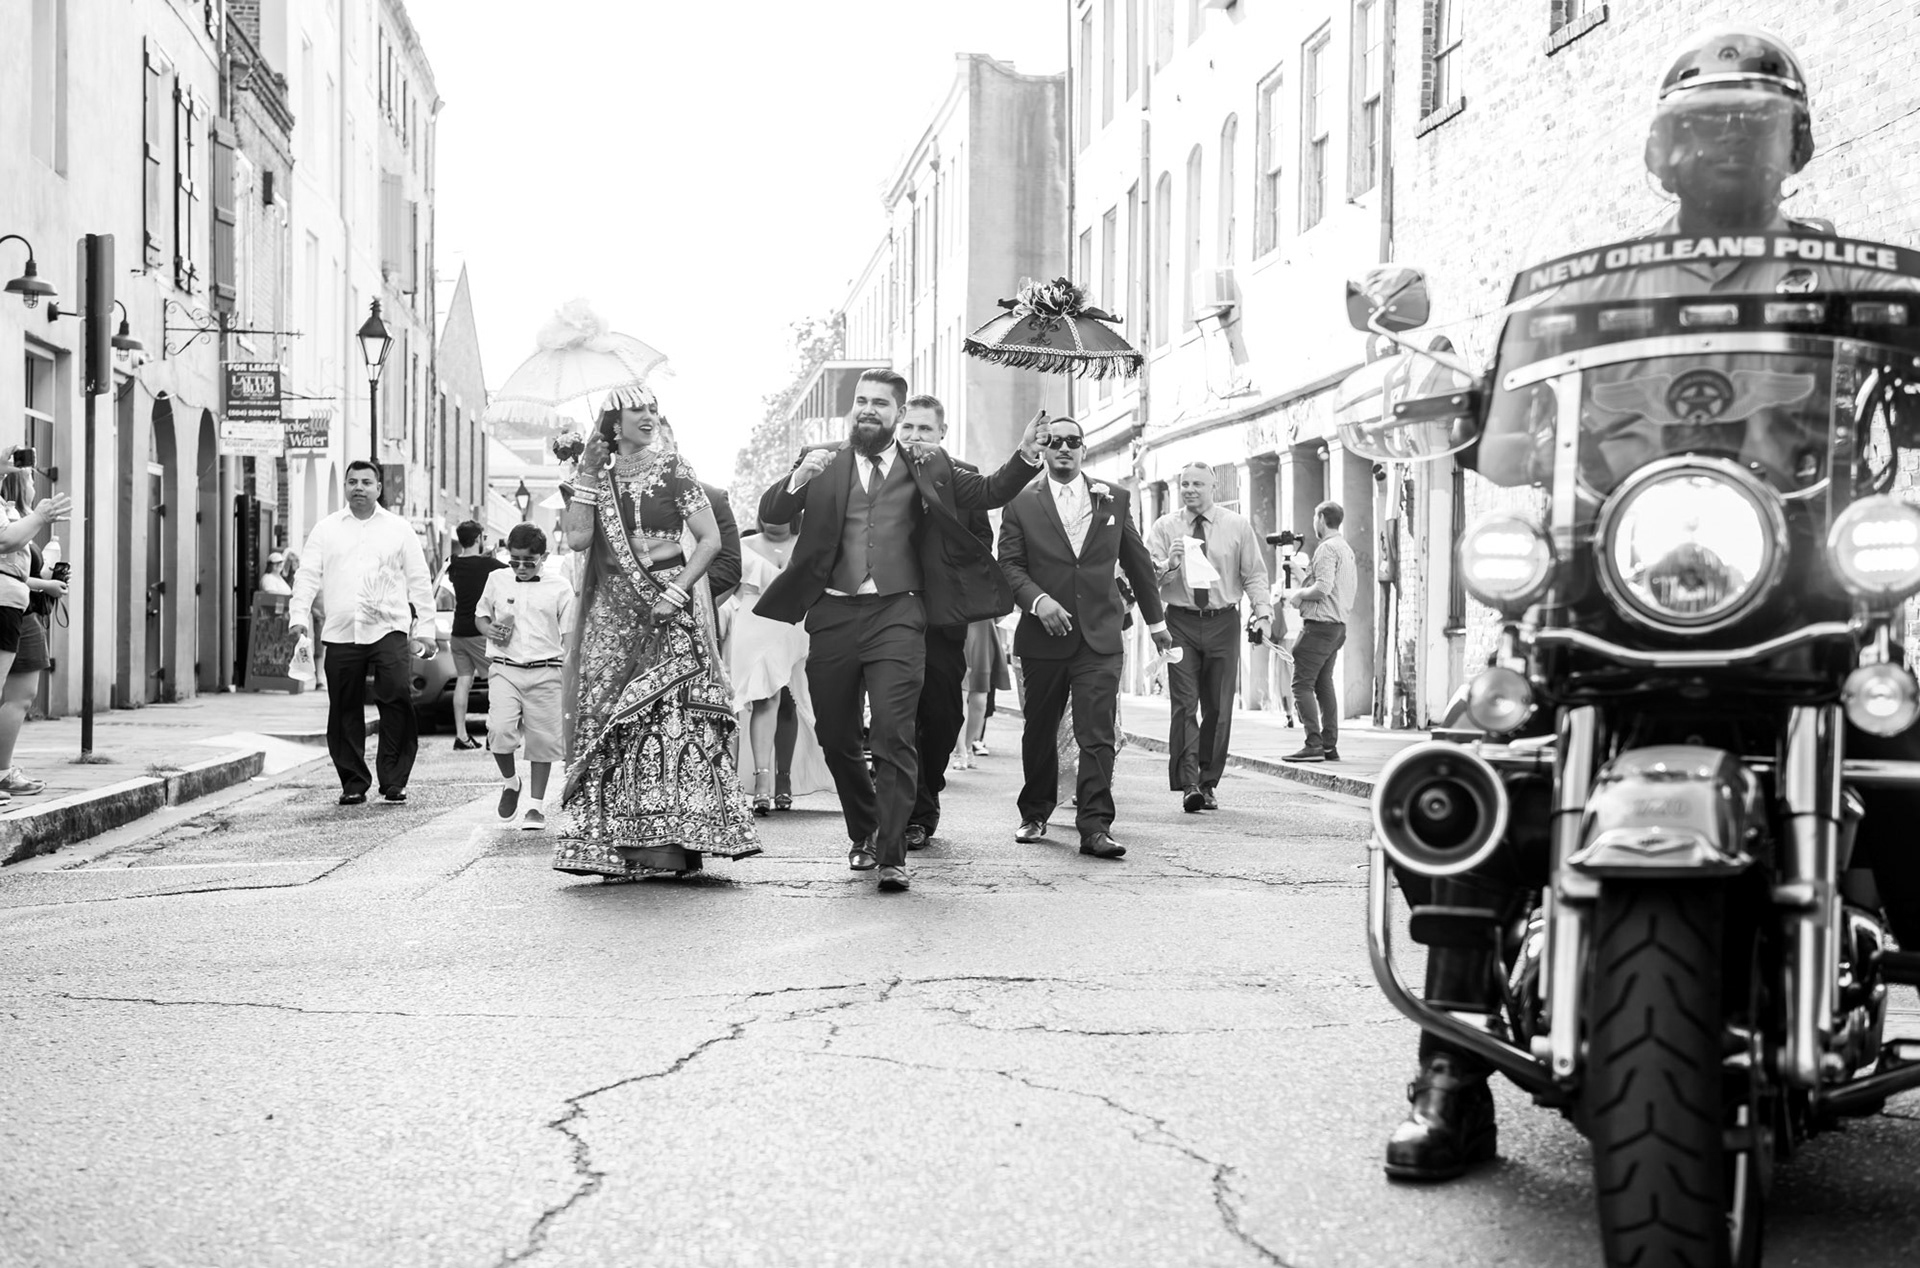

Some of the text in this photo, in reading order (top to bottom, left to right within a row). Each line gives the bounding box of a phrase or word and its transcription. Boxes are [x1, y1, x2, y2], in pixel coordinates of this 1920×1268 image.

[1529, 236, 1898, 292] NEW ORLEANS POLICE
[228, 363, 279, 372] FOR LEASE
[232, 375, 274, 386] LATTER
[243, 383, 275, 394] BLUM
[290, 433, 327, 447] Water
